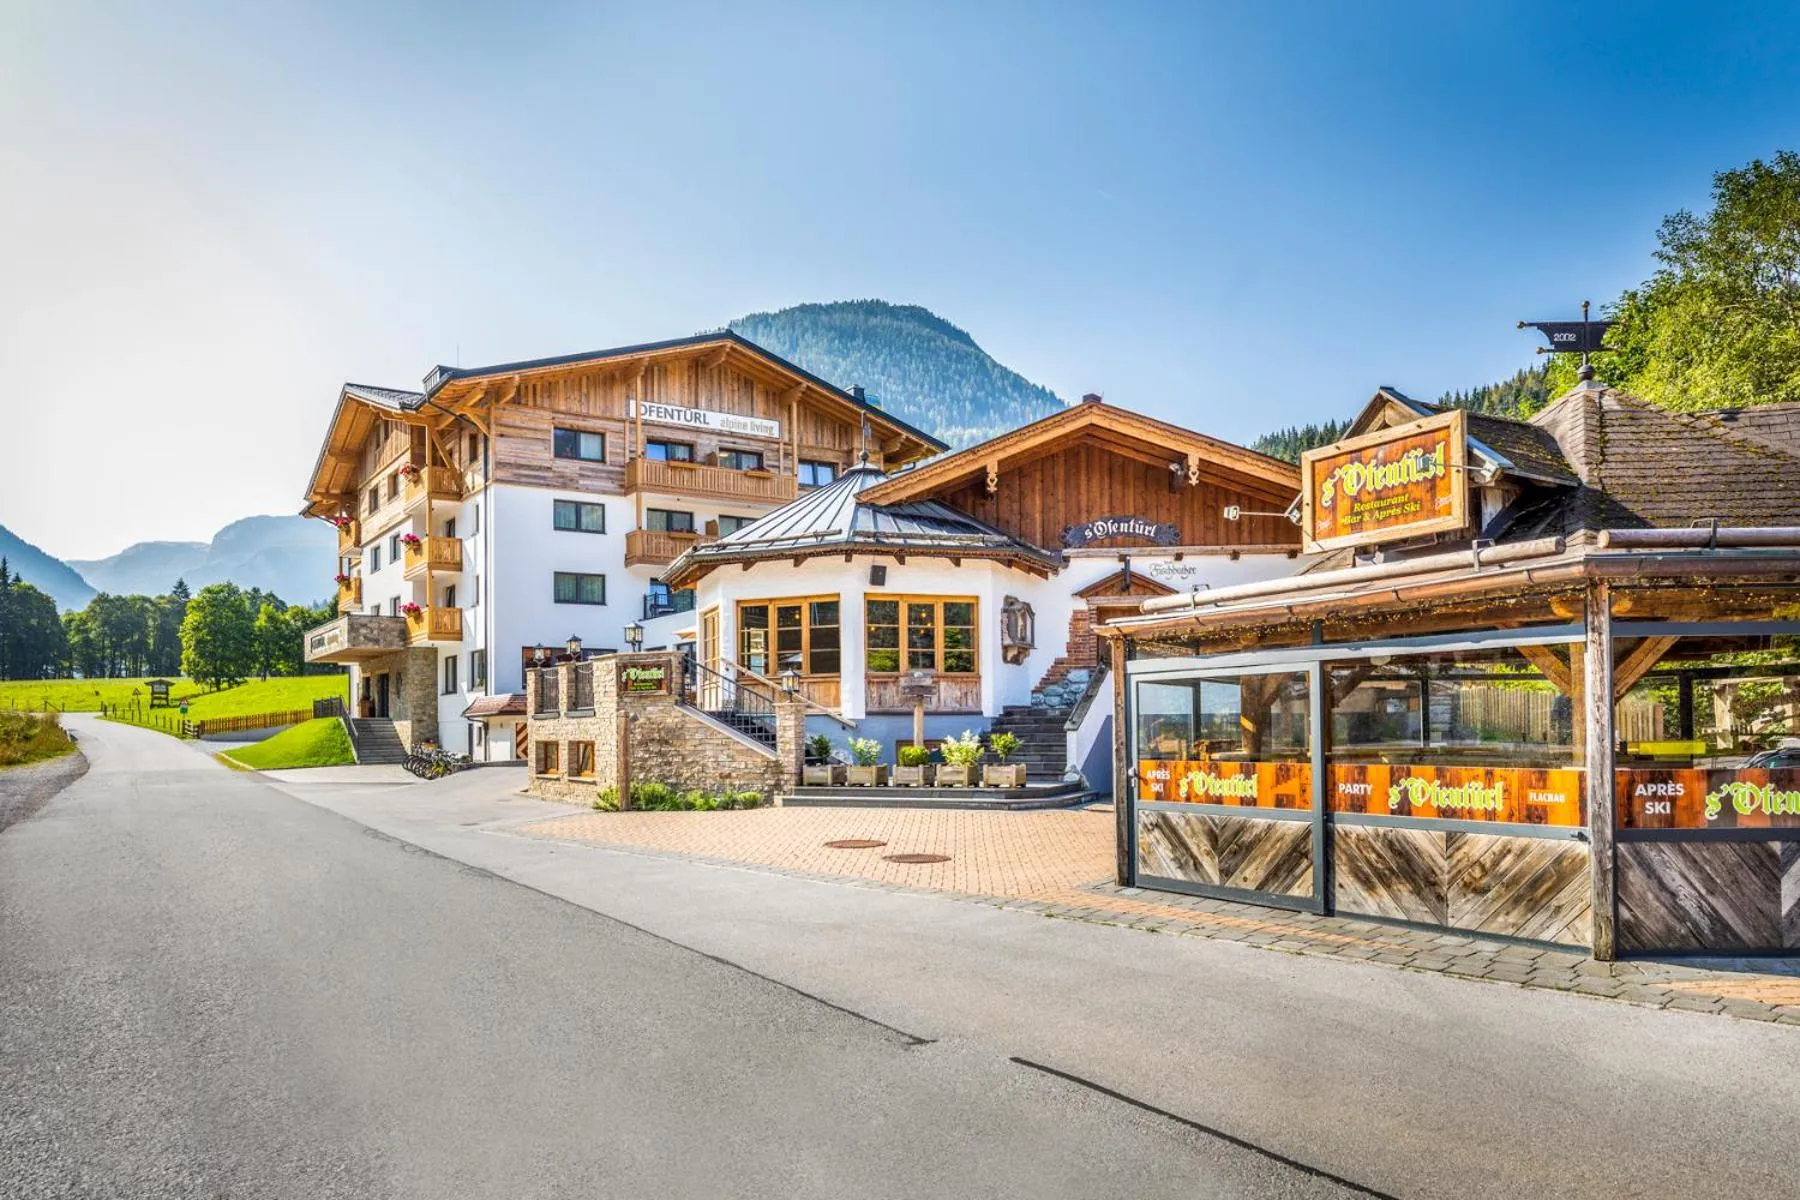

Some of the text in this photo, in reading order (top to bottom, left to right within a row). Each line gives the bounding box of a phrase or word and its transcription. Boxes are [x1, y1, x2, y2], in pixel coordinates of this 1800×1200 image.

[1553, 332, 1577, 342] 2002
[720, 416, 748, 432] alpine
[1354, 494, 1409, 512] Restaurant
[1343, 513, 1362, 525] Bar
[1362, 509, 1370, 522] &
[1403, 500, 1421, 514] Ski
[1338, 783, 1372, 795] PARTY
[1635, 780, 1685, 796] APRÈS
[1645, 801, 1671, 815] SKI
